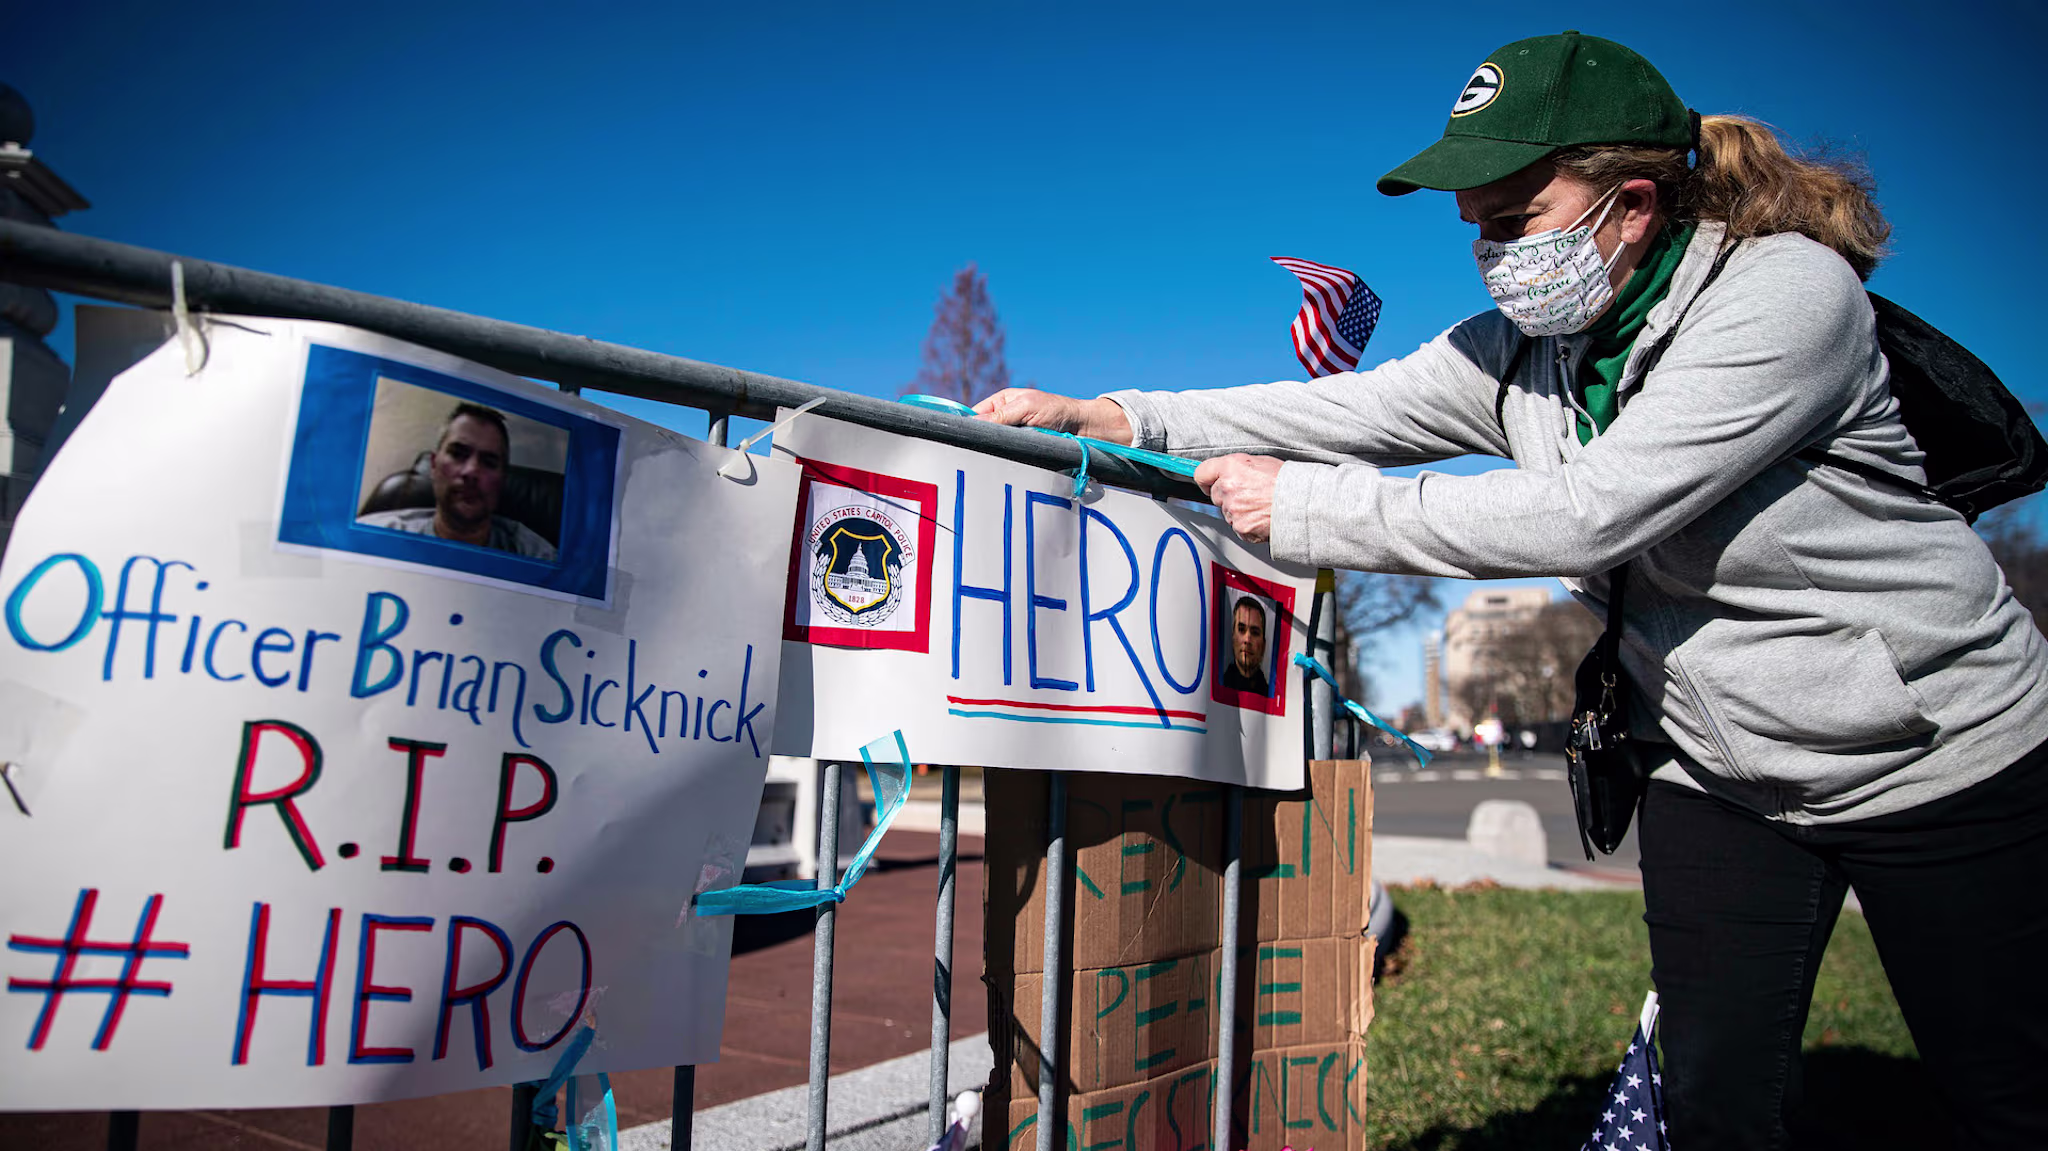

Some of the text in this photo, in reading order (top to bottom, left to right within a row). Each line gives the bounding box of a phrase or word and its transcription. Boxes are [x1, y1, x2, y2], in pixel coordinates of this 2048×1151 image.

[1451, 64, 1502, 116] G
[808, 507, 913, 559] UNITED STATES CAPITOL POLICE
[848, 595, 865, 604] 1828
[951, 469, 1207, 729] HERO
[5, 552, 766, 758] Officer Brian Sicknick
[223, 719, 560, 873] R.I.P.
[231, 901, 593, 1071] HERO
